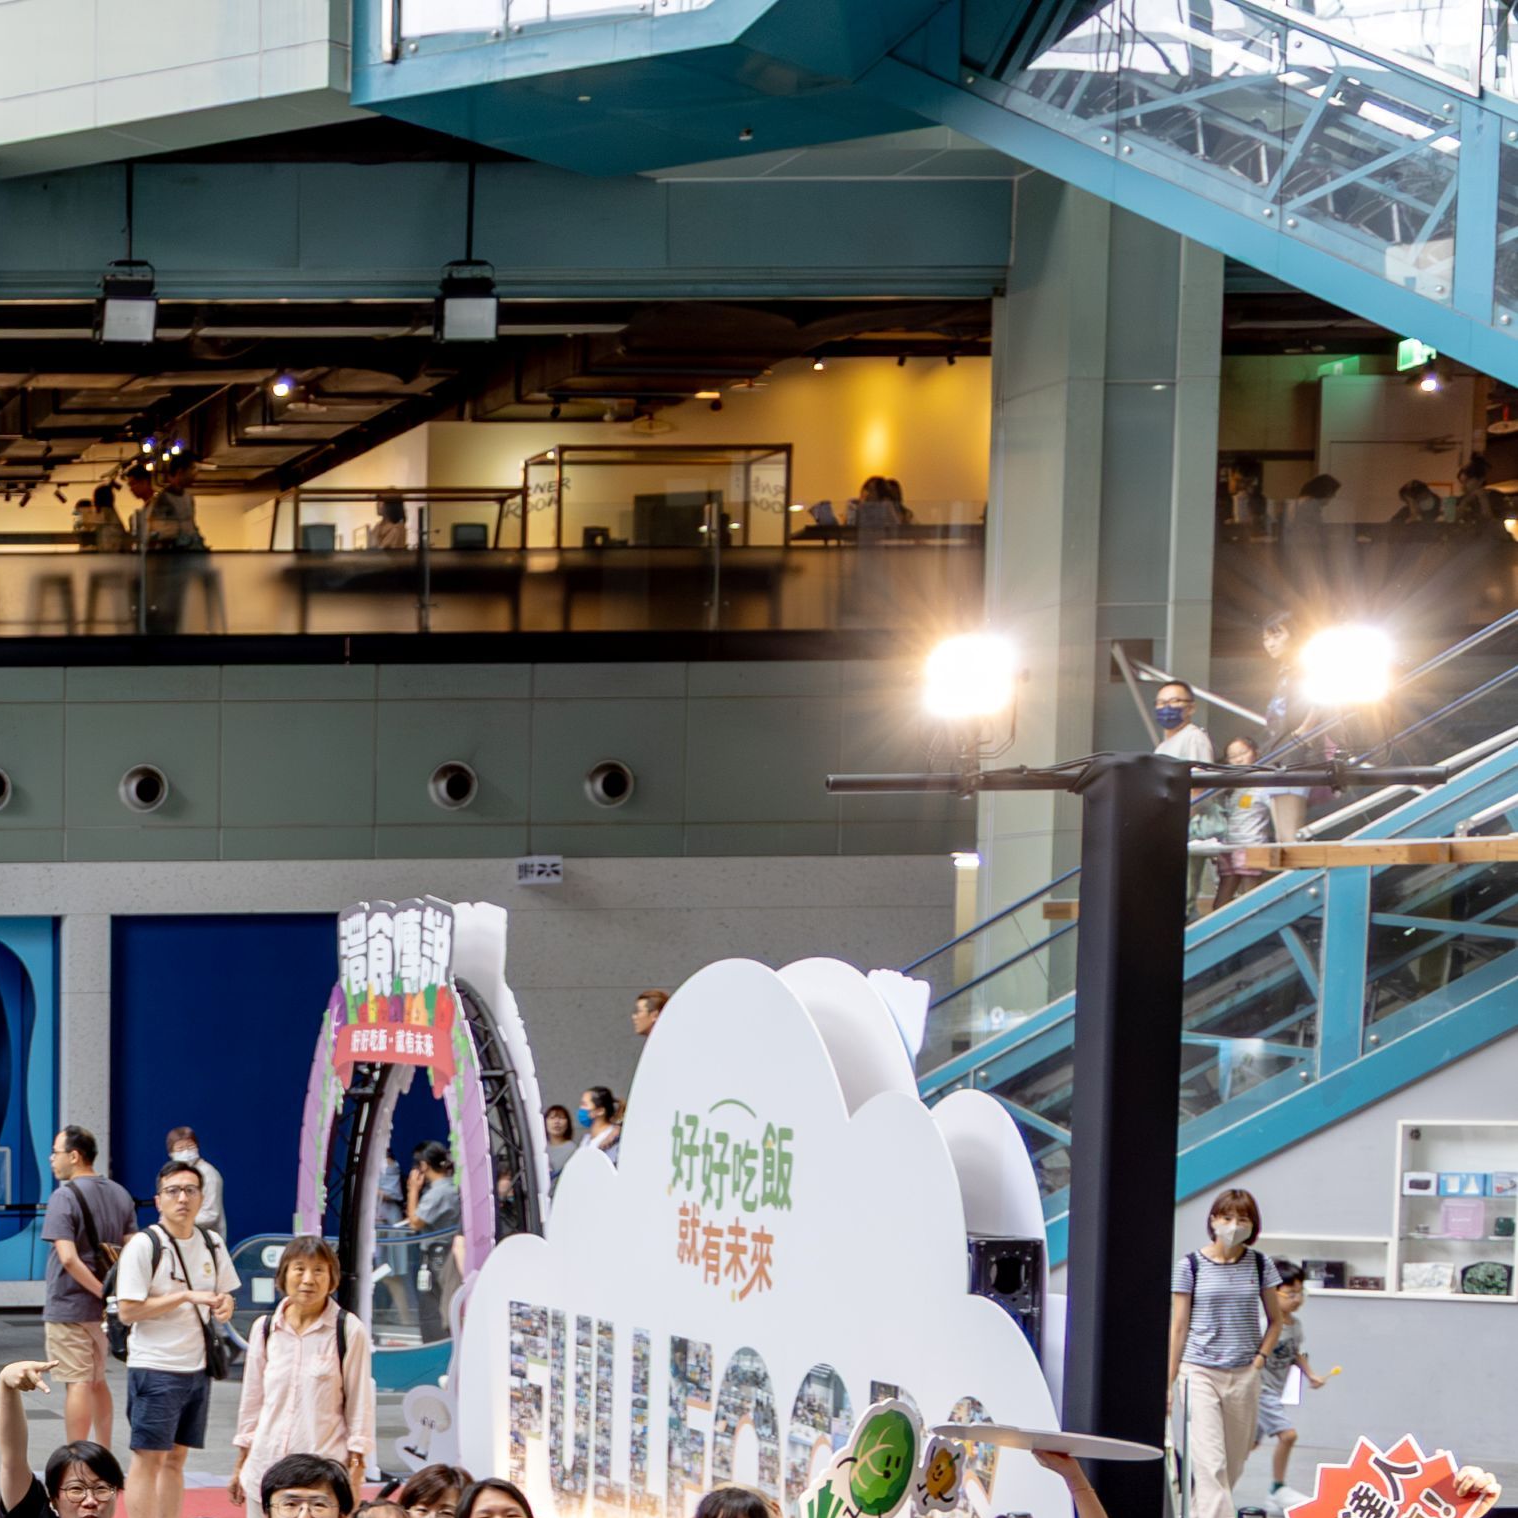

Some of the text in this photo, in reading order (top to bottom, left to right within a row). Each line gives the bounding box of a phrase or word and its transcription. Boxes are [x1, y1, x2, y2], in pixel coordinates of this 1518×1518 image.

[670, 1110, 795, 1212] 好好吃飯
[675, 1204, 776, 1300] 就有未來
